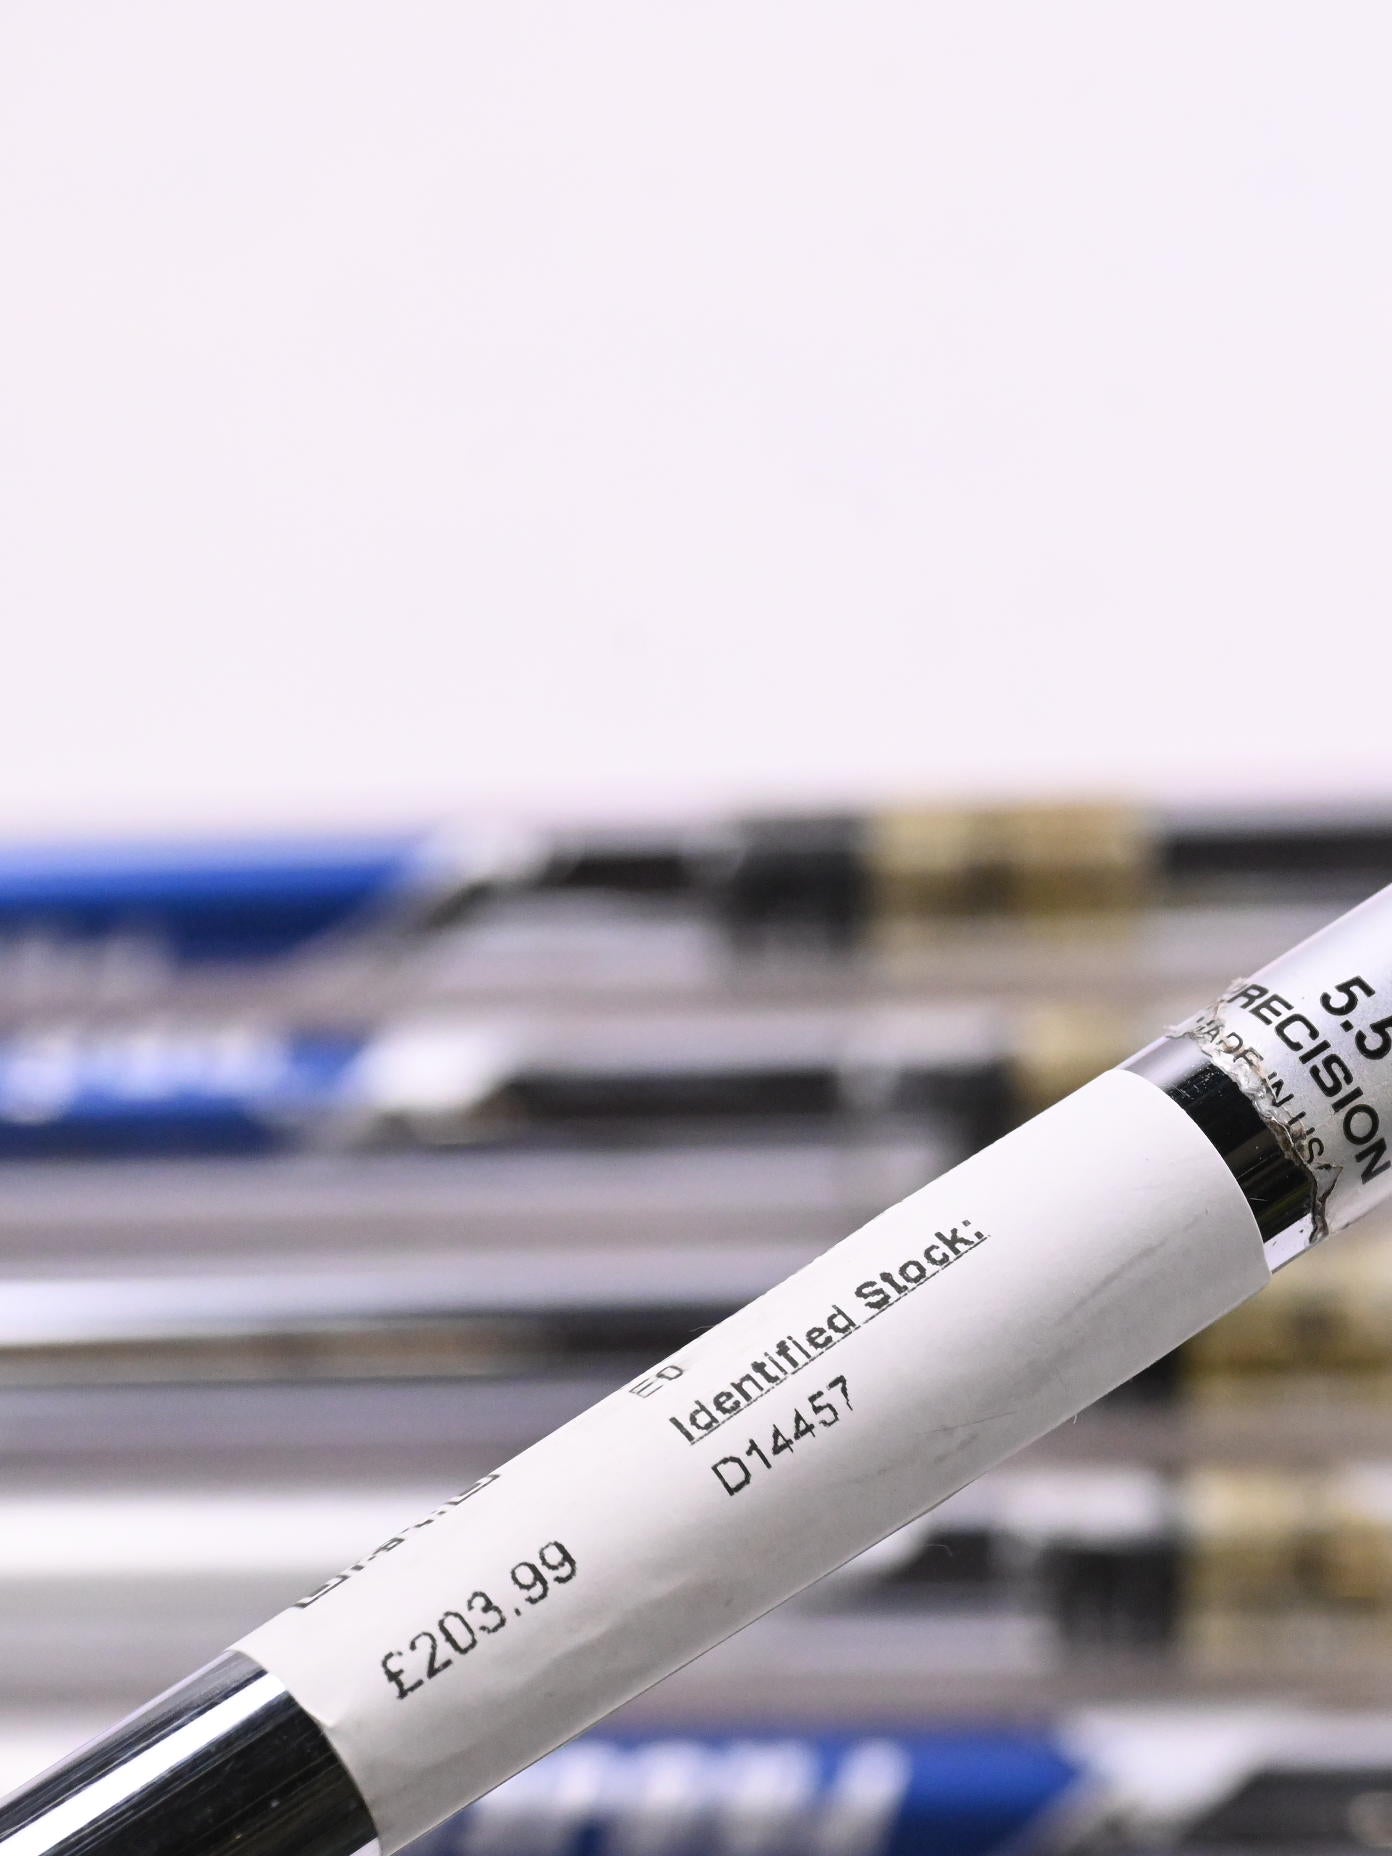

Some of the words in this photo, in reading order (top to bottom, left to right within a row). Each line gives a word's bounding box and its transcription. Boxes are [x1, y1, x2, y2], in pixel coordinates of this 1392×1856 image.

[1226, 983, 1392, 1185] RECISION
[668, 1304, 857, 1444] Identified
[854, 1219, 990, 1310] Stock:
[711, 1375, 853, 1496] D14457
[381, 1541, 577, 1699] £203.99
